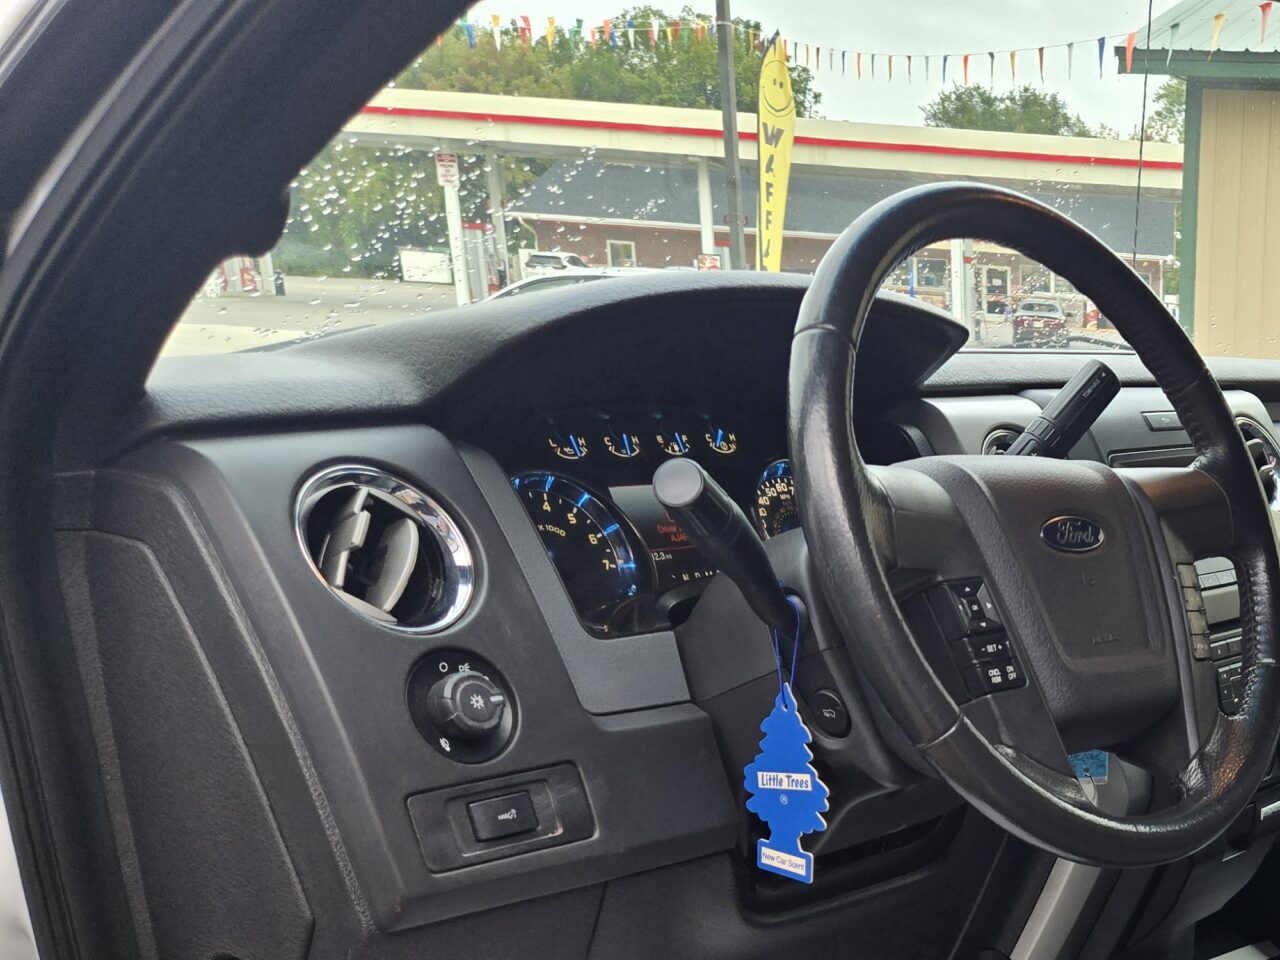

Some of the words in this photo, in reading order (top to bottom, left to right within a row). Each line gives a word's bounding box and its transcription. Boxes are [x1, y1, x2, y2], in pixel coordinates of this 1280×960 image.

[765, 487, 777, 497] 50
[543, 501, 551, 512] 4
[567, 512, 577, 524] 5
[588, 533, 598, 545] 6
[602, 559, 609, 570] 7
[761, 773, 783, 787] Little
[785, 775, 809, 789] Trees
[762, 852, 776, 862] New
[776, 856, 786, 866] Car
[788, 859, 805, 872] Scent
